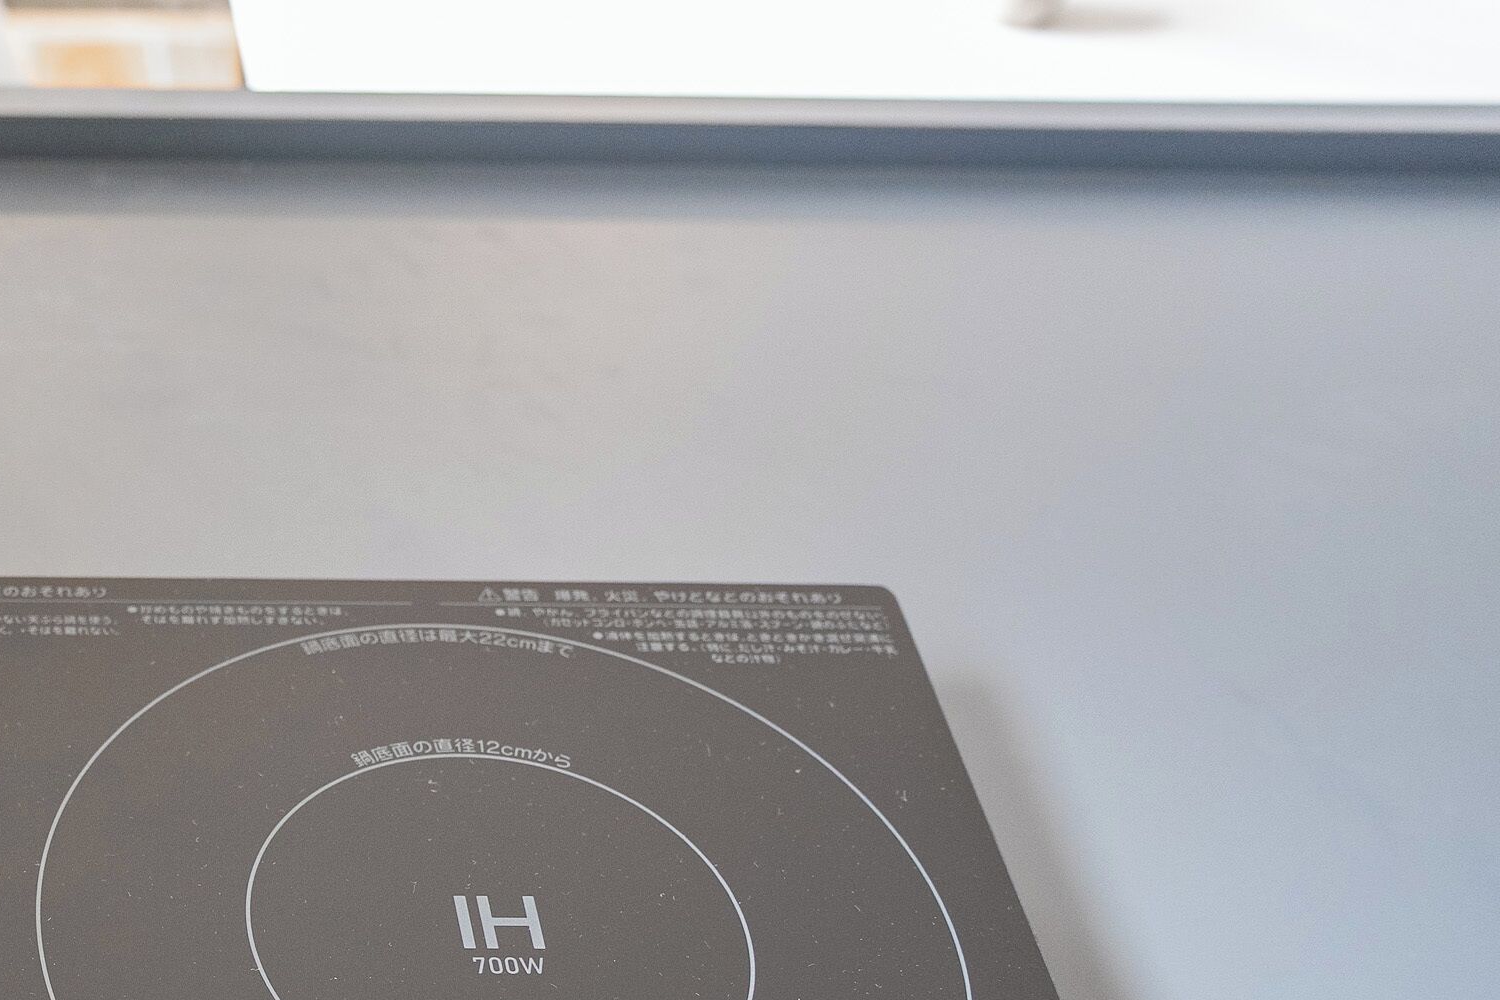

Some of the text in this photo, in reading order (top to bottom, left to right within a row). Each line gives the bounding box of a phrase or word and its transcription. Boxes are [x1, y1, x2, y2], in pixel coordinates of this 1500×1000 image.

[300, 629, 574, 658] 鍋底面の直径は最大22cmまで
[350, 738, 571, 768] 鍋底面の直径12cmから
[453, 895, 546, 949] IH
[472, 956, 544, 975] 700W
